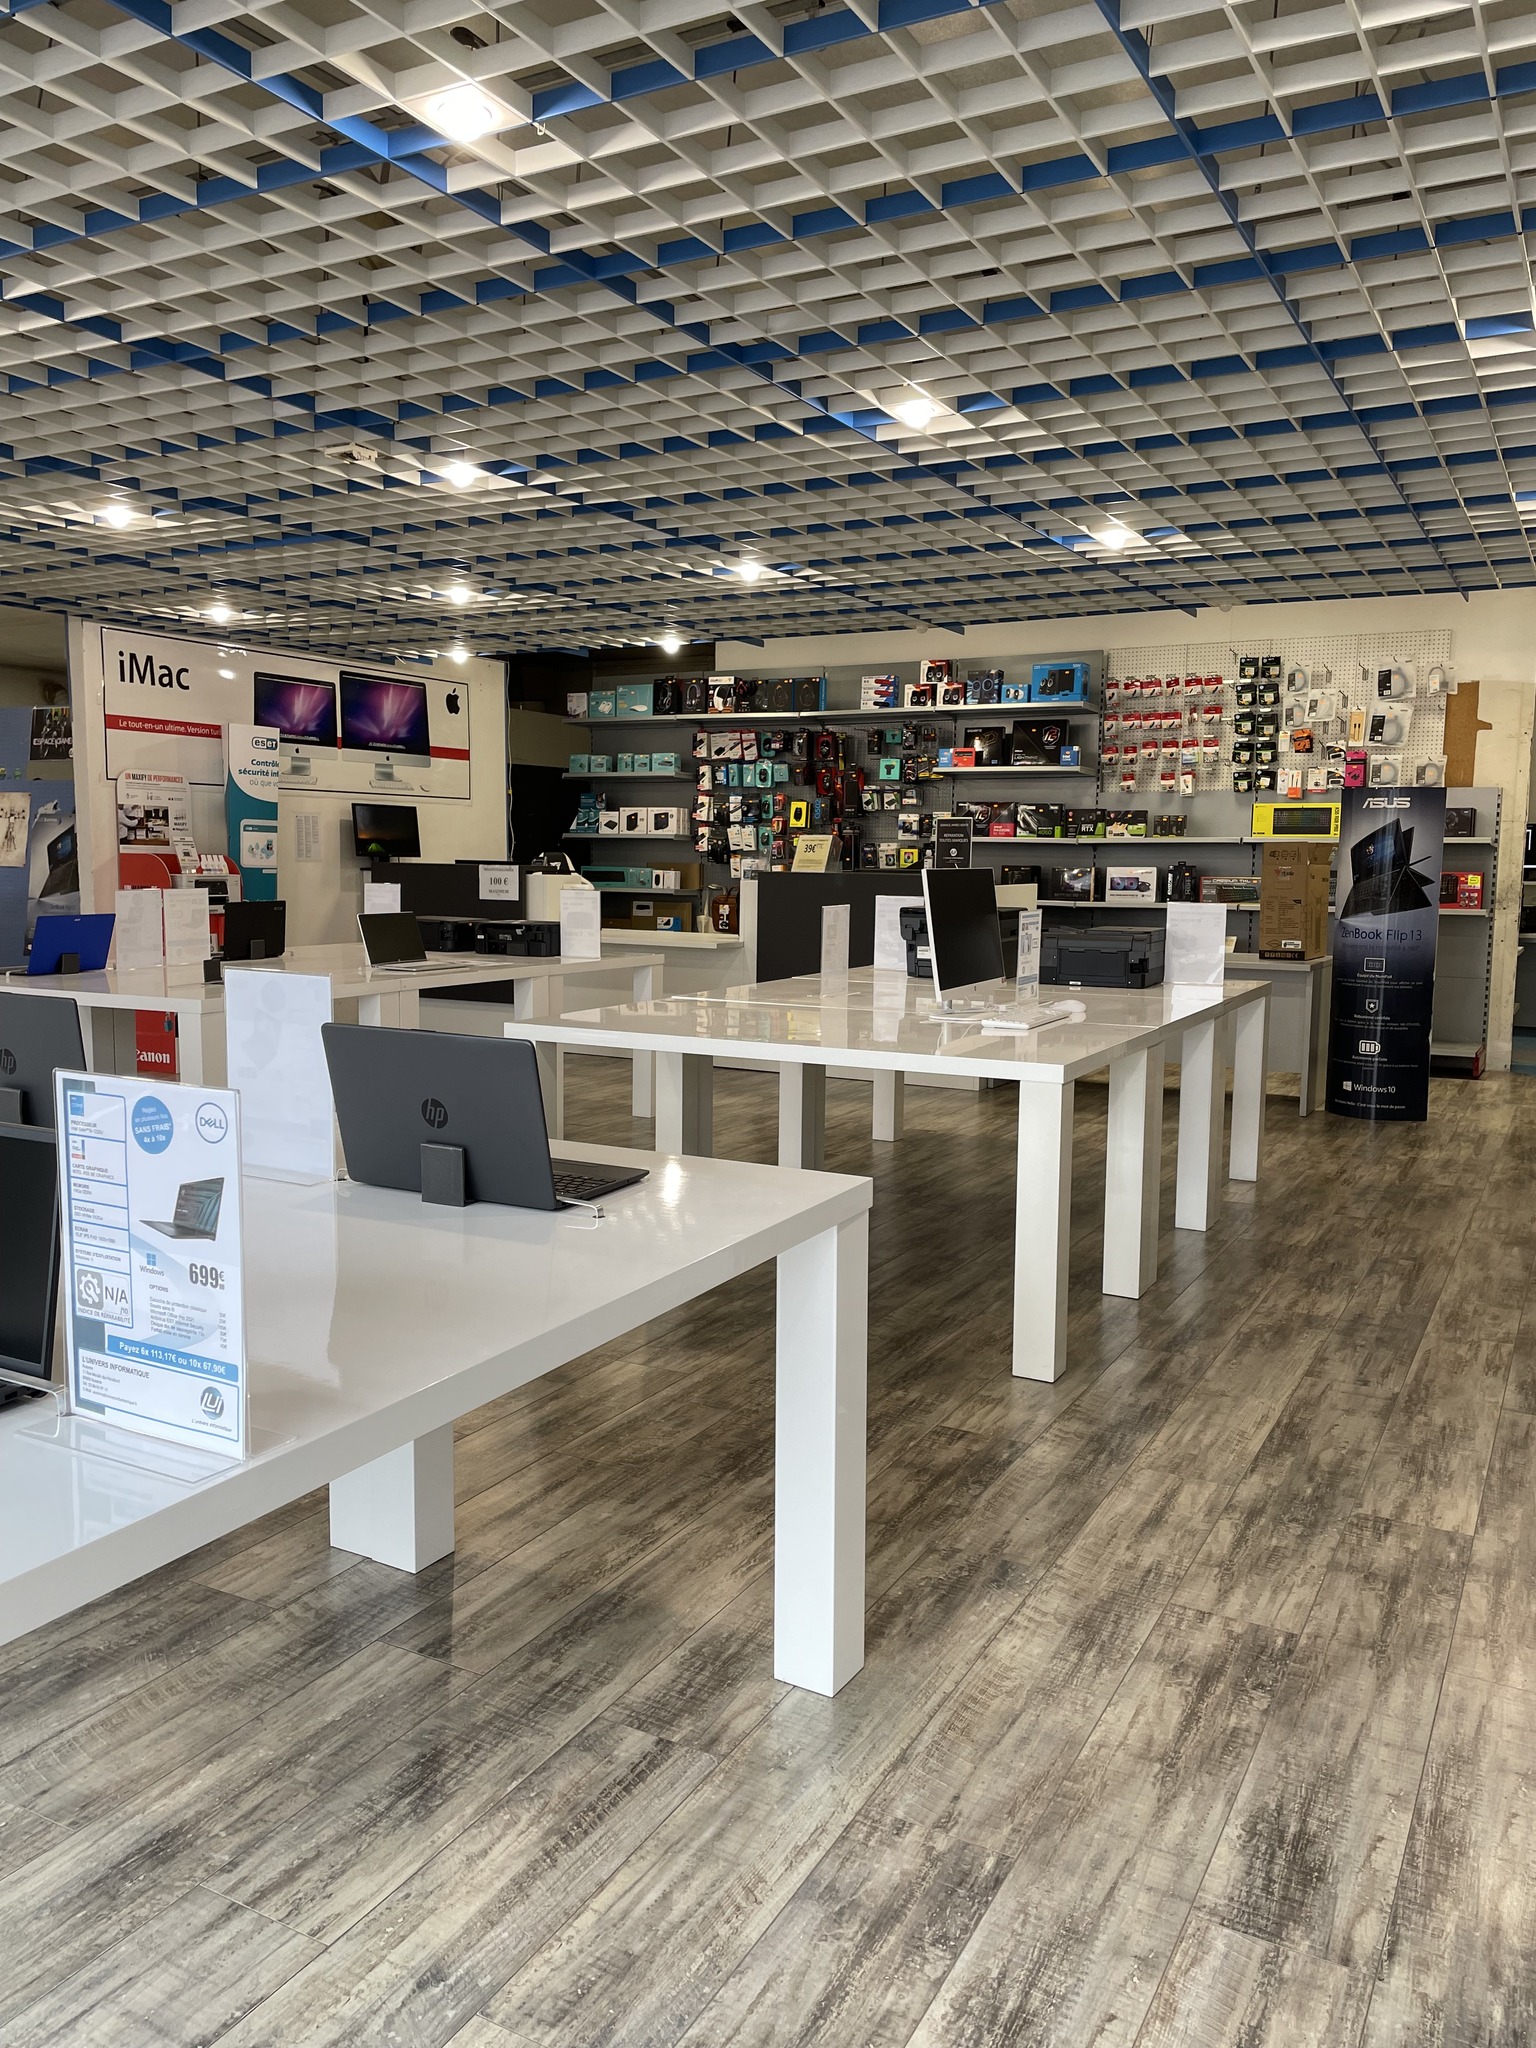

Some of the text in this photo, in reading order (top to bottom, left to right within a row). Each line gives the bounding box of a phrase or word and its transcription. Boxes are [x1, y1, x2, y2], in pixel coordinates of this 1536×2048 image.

[118, 650, 190, 690] iMac
[119, 719, 128, 728] Le
[128, 720, 164, 731] tout-en-un
[164, 724, 186, 732] ultime.
[187, 725, 210, 734] Version
[238, 768, 270, 776] sécurité
[1362, 798, 1411, 808] ASUS
[804, 844, 816, 853] 39€
[490, 877, 508, 885] 100 €
[1342, 927, 1422, 943] ZenBook Flip 13
[1354, 1084, 1387, 1093] Windows
[424, 1098, 446, 1129] hp
[200, 1117, 224, 1129] DELL
[135, 1126, 150, 1134] SANS
[139, 1265, 164, 1276] Windows
[149, 1284, 168, 1292] OPTIONS
[105, 1286, 128, 1305] N/A
[120, 1307, 128, 1315] /10
[120, 1342, 139, 1354] Payez
[141, 1347, 149, 1356] 6x
[150, 1349, 176, 1363] 113,17€
[189, 1358, 201, 1368] 10x
[203, 1362, 226, 1374] 67,90€
[82, 1356, 150, 1378] L'UNIVERS INFORMATIQUE
